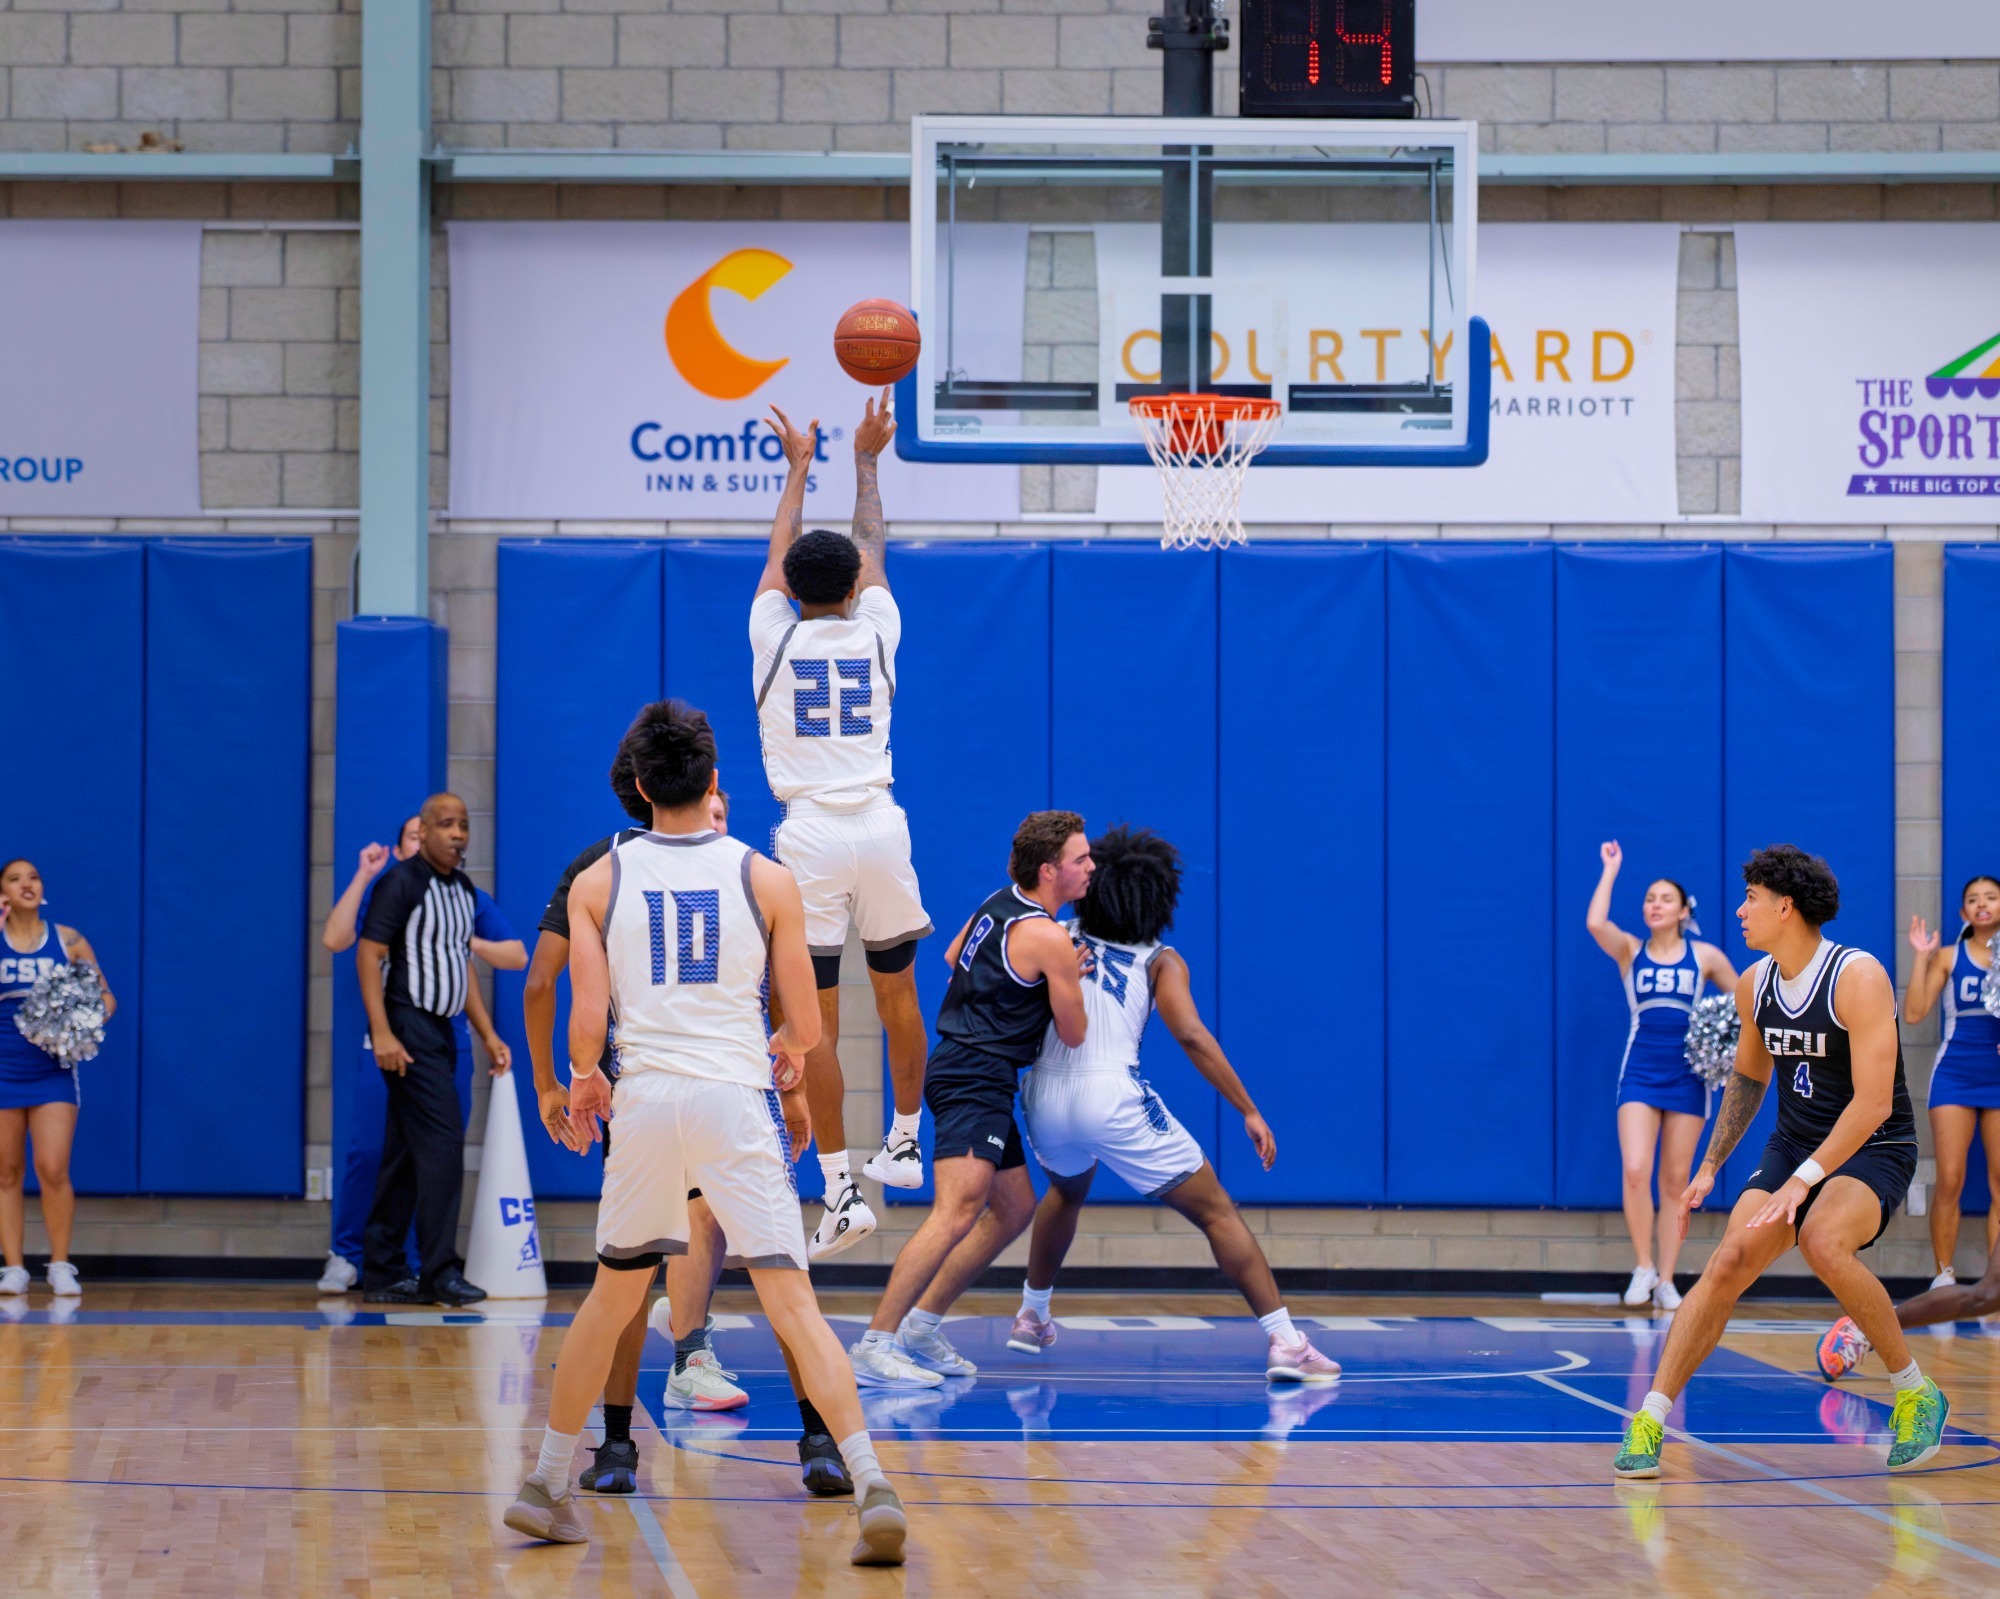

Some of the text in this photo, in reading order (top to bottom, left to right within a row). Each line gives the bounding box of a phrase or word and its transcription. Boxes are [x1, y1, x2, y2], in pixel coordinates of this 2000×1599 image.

[1856, 379, 1913, 407] THE
[631, 420, 829, 462] Comfot
[1857, 410, 2000, 469] SPORT
[646, 474, 818, 493] INN & SUITS
[1889, 479, 1919, 493] THE
[1925, 479, 1952, 493] BIG
[1957, 479, 1988, 493] TOP
[789, 658, 873, 737] 22
[642, 889, 720, 985] 10
[1764, 1027, 1827, 1057] GCU
[1793, 1062, 1814, 1098] 4
